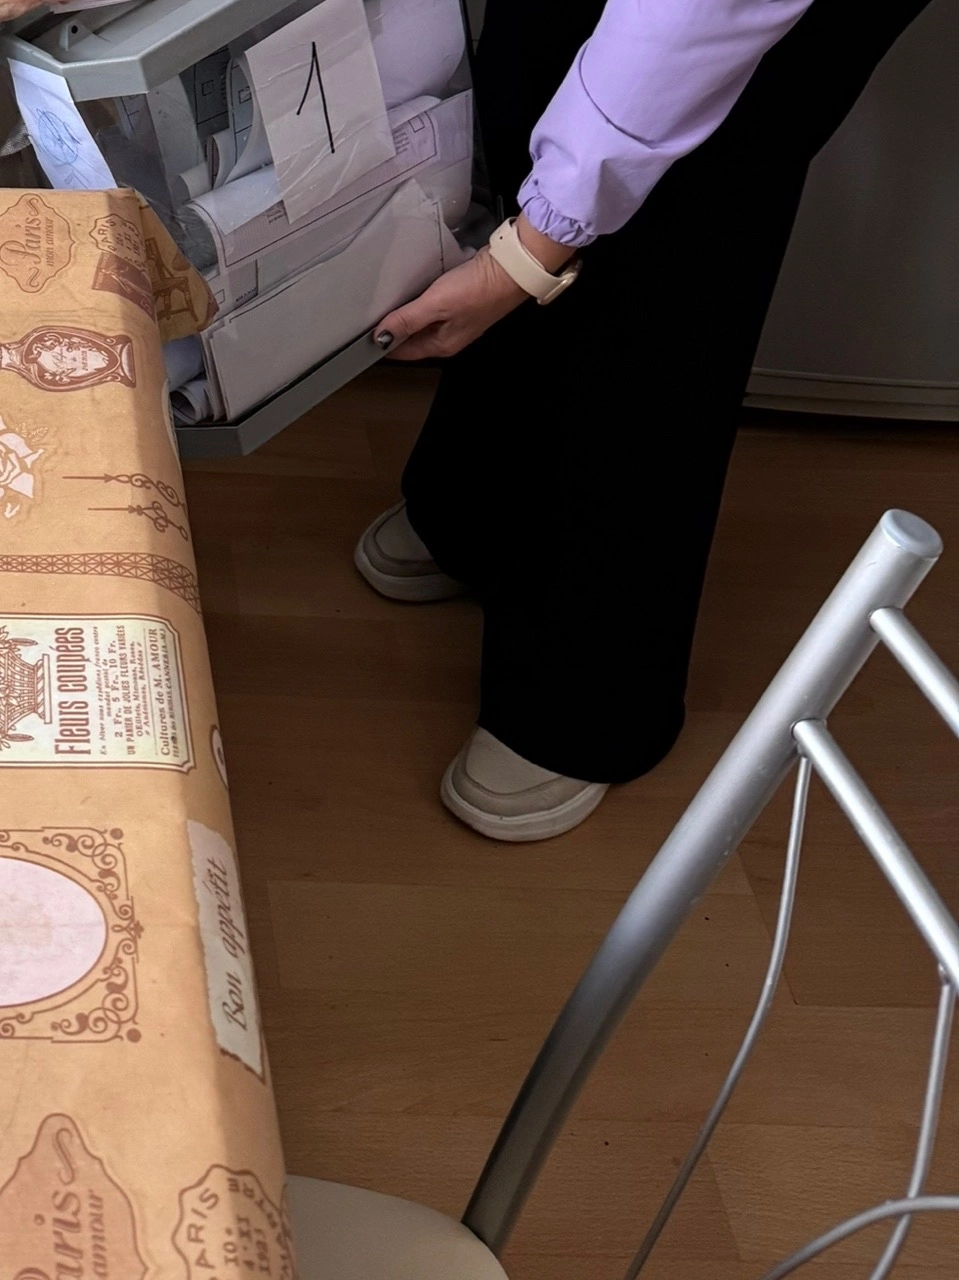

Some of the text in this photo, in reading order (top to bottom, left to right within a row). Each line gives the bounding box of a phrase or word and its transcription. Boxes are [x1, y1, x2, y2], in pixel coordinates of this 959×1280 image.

[296, 41, 335, 153] 1
[108, 641, 116, 653] Fr.
[110, 659, 117, 668] 10
[120, 653, 128, 677] FLEURS
[49, 627, 92, 755] Fleurs coupées
[122, 680, 131, 703] JOLIES
[149, 628, 171, 755] Cultures de M. AMOUR
[124, 706, 132, 714] DE
[125, 718, 134, 742] PANIER
[202, 856, 248, 1032] Bon appétit
[187, 1187, 220, 1280] ARIS
